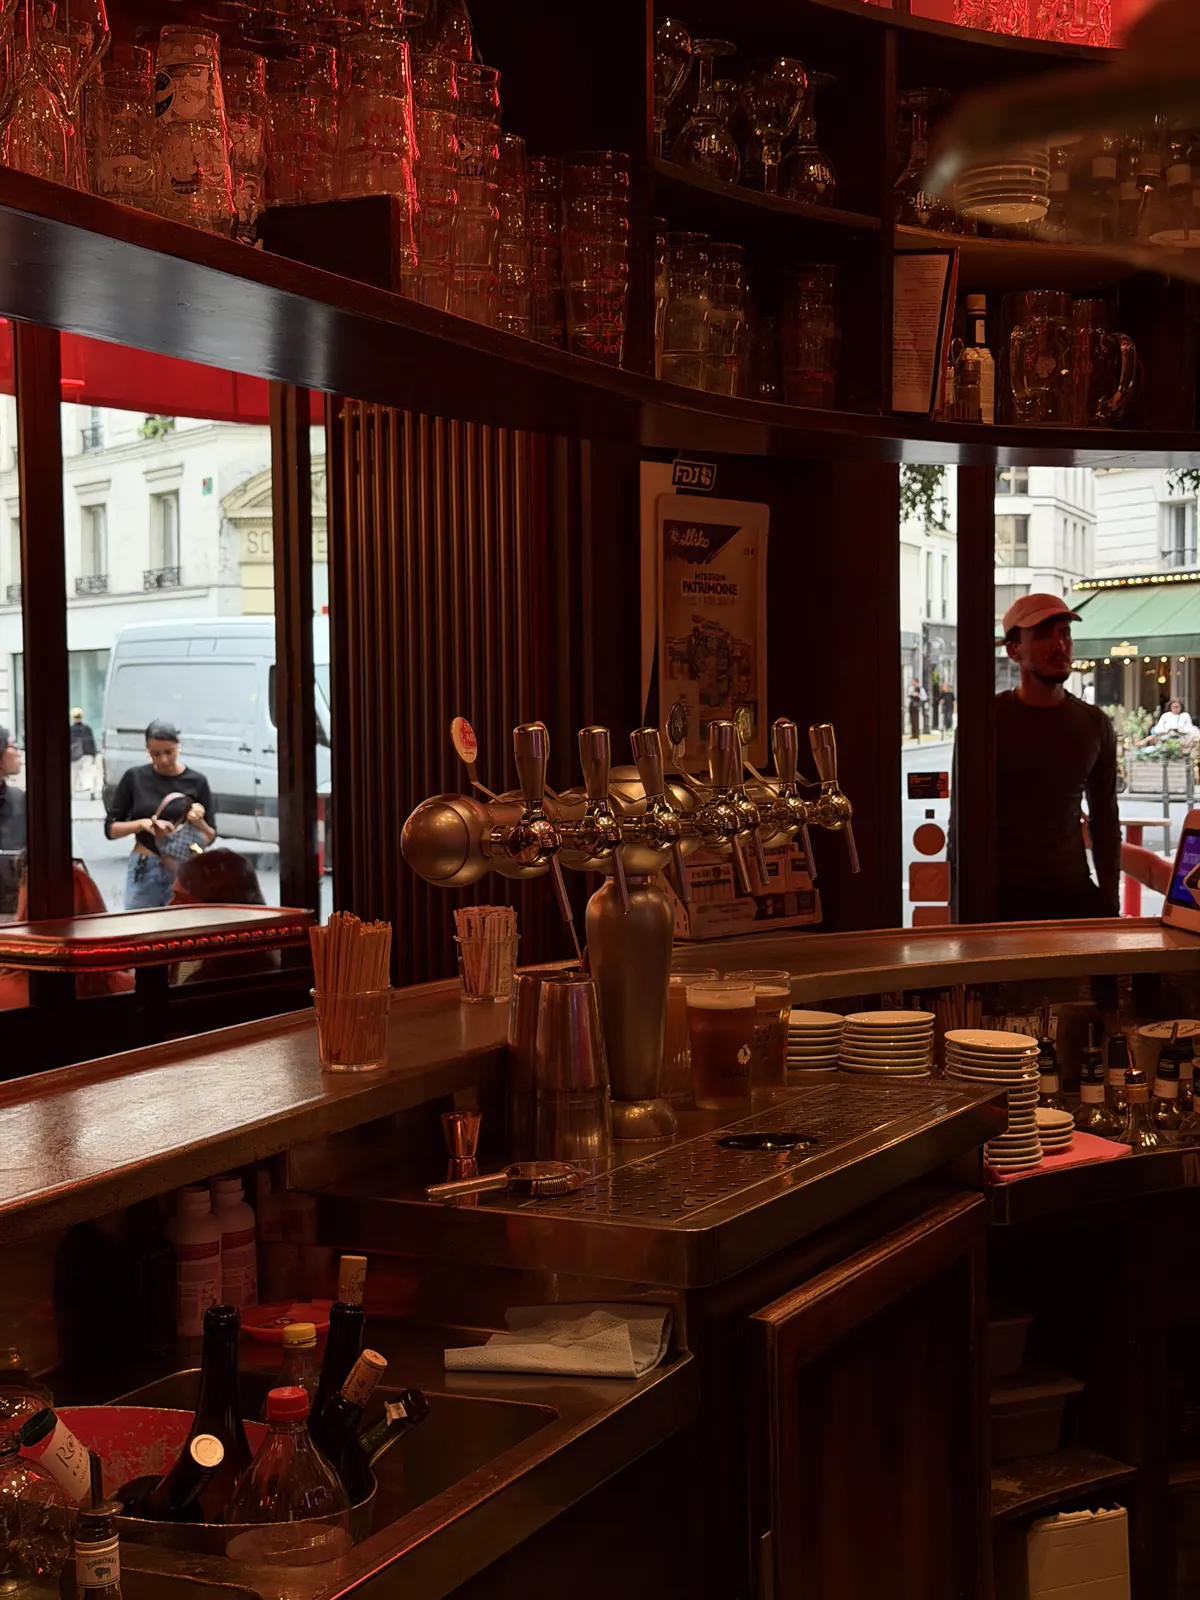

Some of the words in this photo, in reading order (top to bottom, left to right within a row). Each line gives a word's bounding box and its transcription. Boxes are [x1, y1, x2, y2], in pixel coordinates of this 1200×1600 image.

[674, 465, 700, 484] FDJ
[694, 571, 727, 582] MISSION
[682, 580, 738, 596] PATRIMOINE
